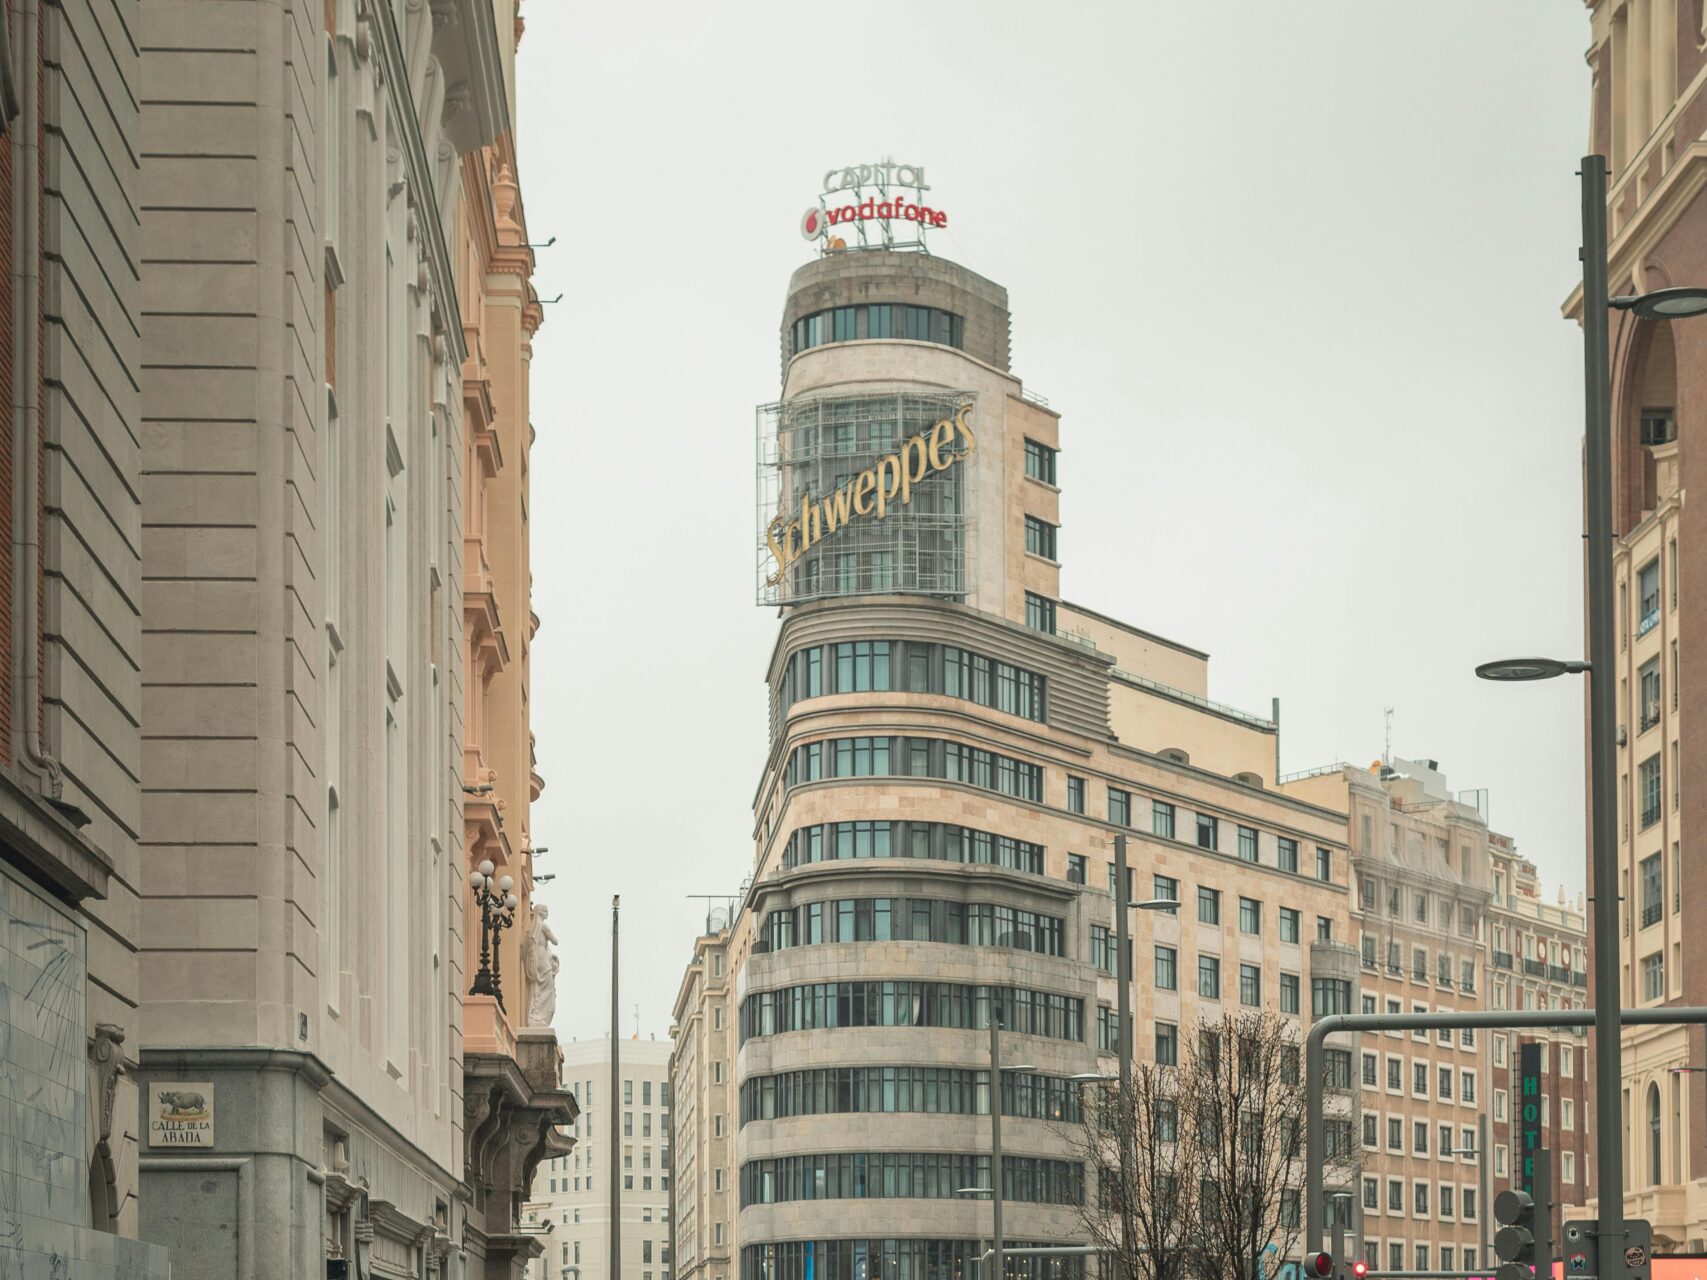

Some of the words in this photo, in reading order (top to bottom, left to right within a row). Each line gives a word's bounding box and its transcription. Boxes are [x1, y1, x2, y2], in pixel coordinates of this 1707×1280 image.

[823, 163, 931, 193] CAPITOL
[826, 196, 948, 229] vodafone
[766, 403, 976, 588] Schweppes
[151, 1121, 185, 1131] CALLE
[187, 1122, 198, 1130] DE
[199, 1122, 210, 1130] LA
[162, 1131, 201, 1143] ABADA
